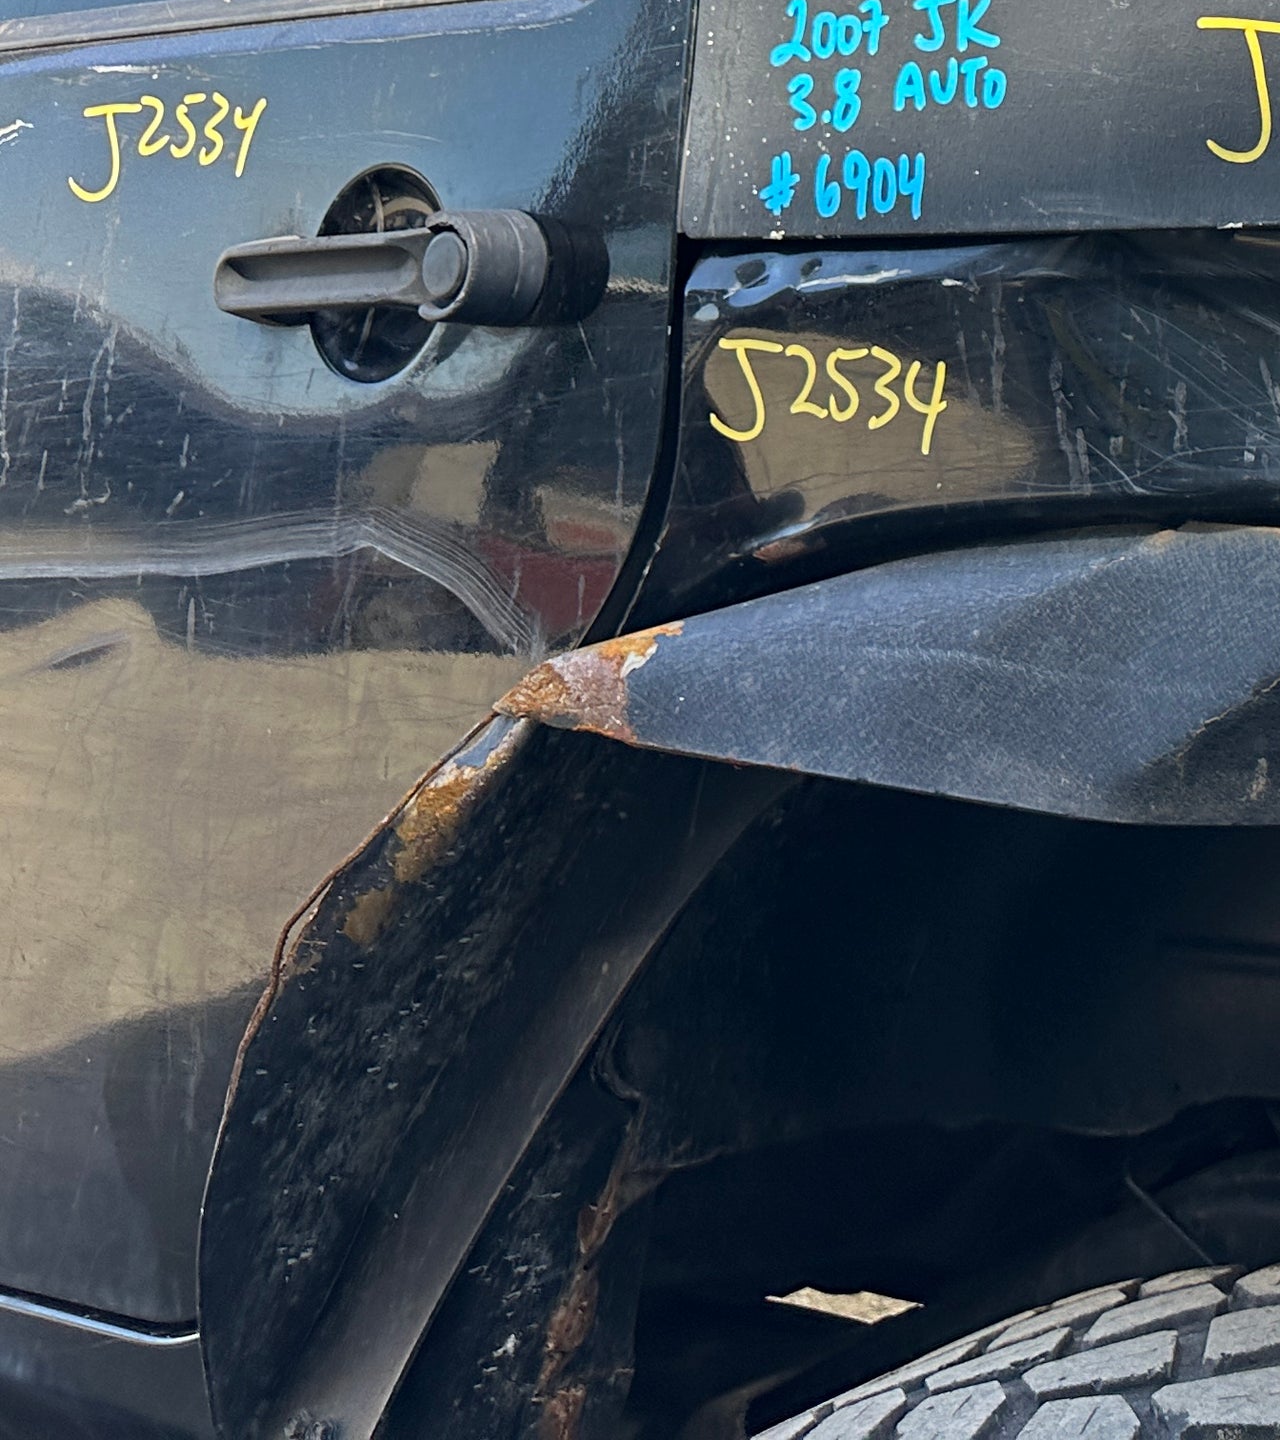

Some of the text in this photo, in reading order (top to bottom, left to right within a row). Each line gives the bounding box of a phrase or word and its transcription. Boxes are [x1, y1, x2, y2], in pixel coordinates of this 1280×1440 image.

[67, 92, 267, 202] J2534
[786, 55, 1007, 133] 3.8 AUTO
[709, 337, 949, 455] J2534
